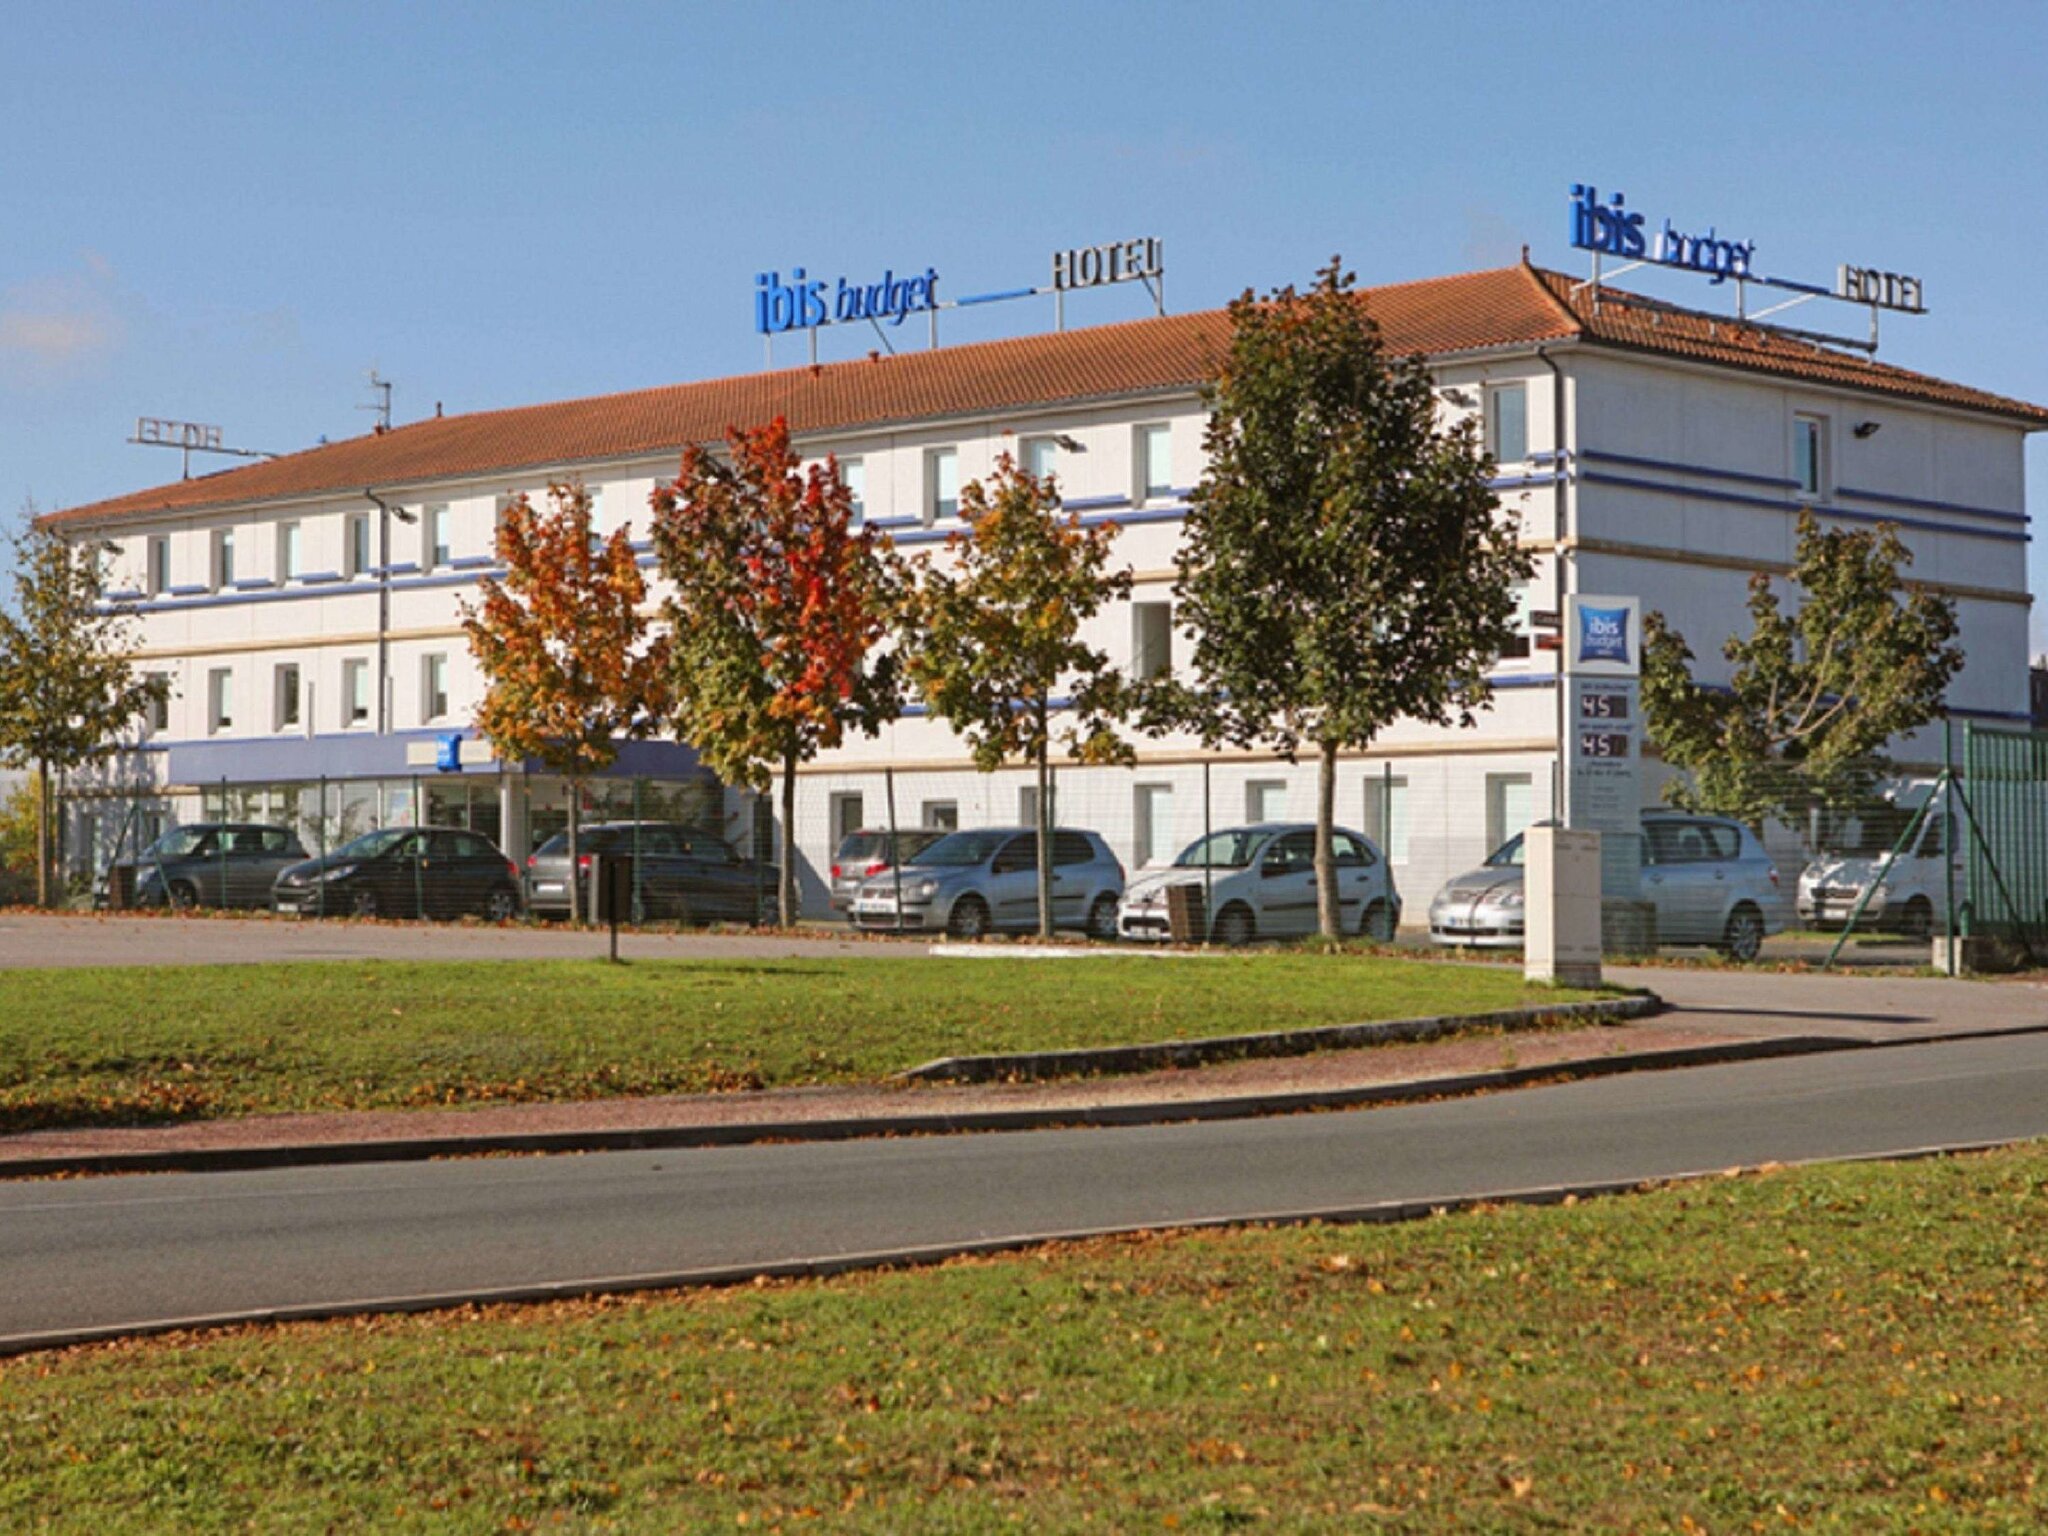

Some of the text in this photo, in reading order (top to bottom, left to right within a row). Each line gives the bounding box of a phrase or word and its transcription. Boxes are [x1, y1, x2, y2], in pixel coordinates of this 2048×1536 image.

[1569, 184, 1646, 257] ibis
[755, 237, 1163, 333] ibis budget HOTEL
[1588, 617, 1619, 635] ibis
[1581, 694, 1611, 718] 45
[1581, 734, 1611, 757] 45
